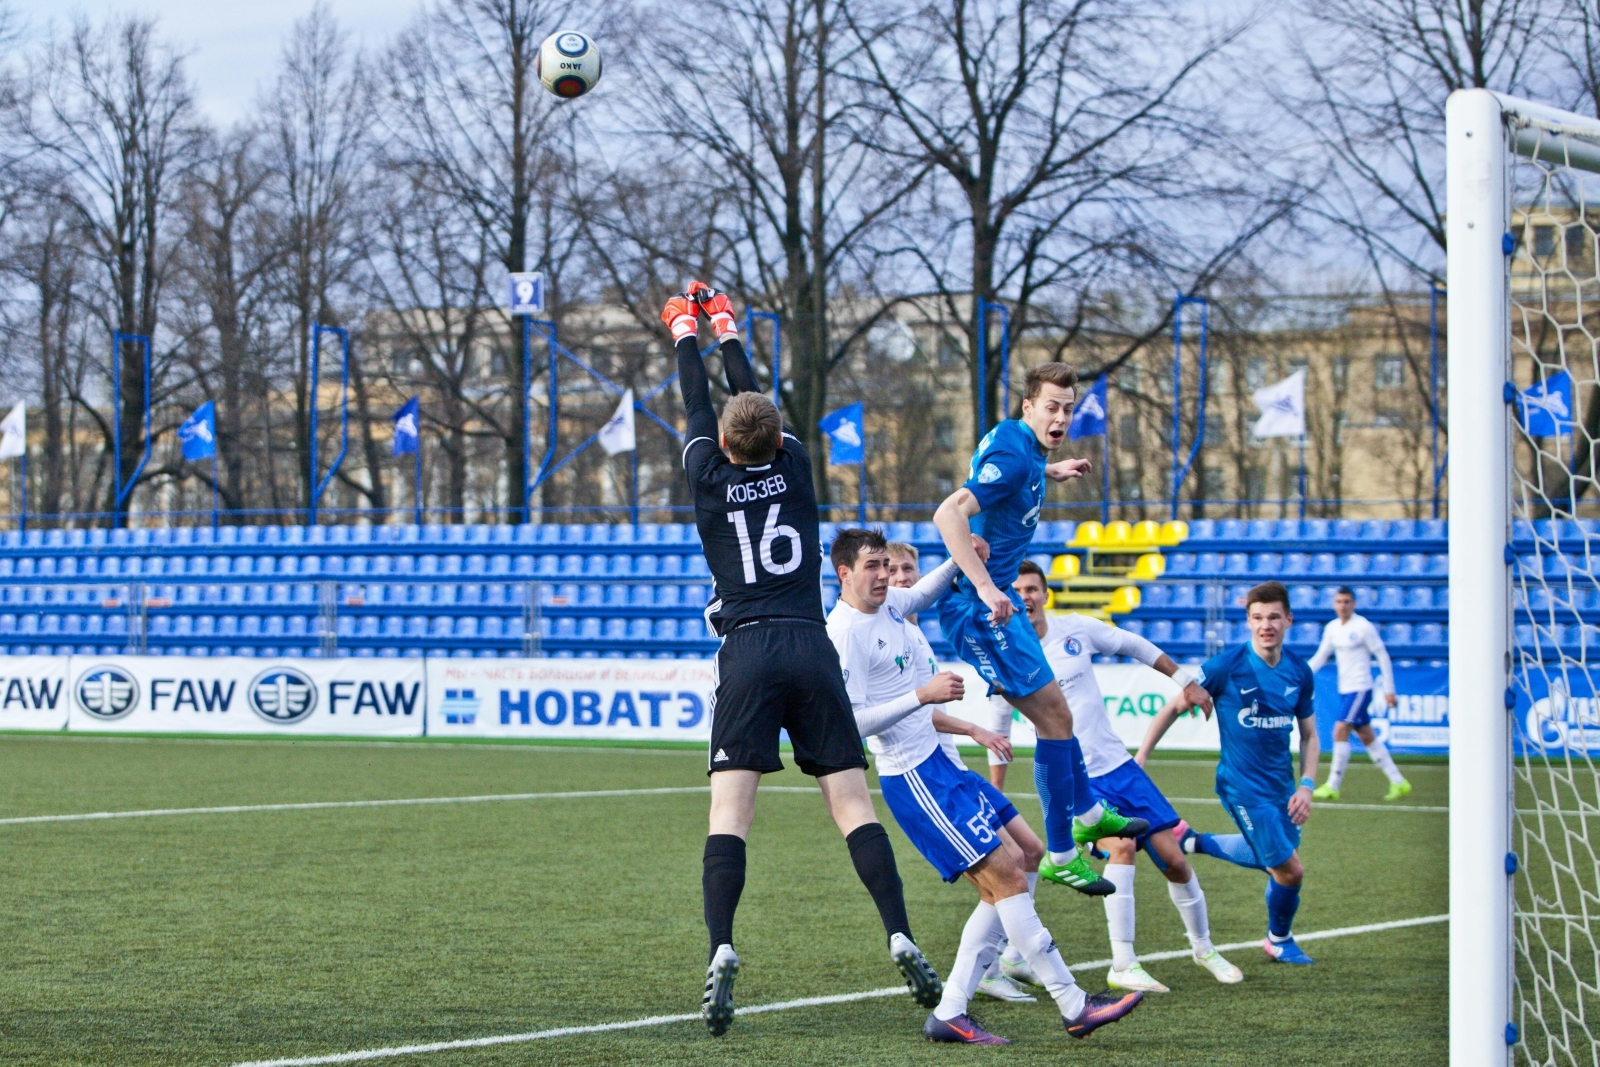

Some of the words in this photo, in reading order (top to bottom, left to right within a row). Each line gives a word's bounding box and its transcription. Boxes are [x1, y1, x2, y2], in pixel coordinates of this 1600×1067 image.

[560, 62, 582, 70] JAKO
[516, 281, 534, 304] 9
[726, 474, 787, 503] КОБЗЕВ
[726, 503, 803, 584] 16
[0, 677, 63, 710] AW
[150, 679, 237, 712] FAW
[329, 680, 421, 716] FAW
[499, 688, 711, 729] НОВАТЭ
